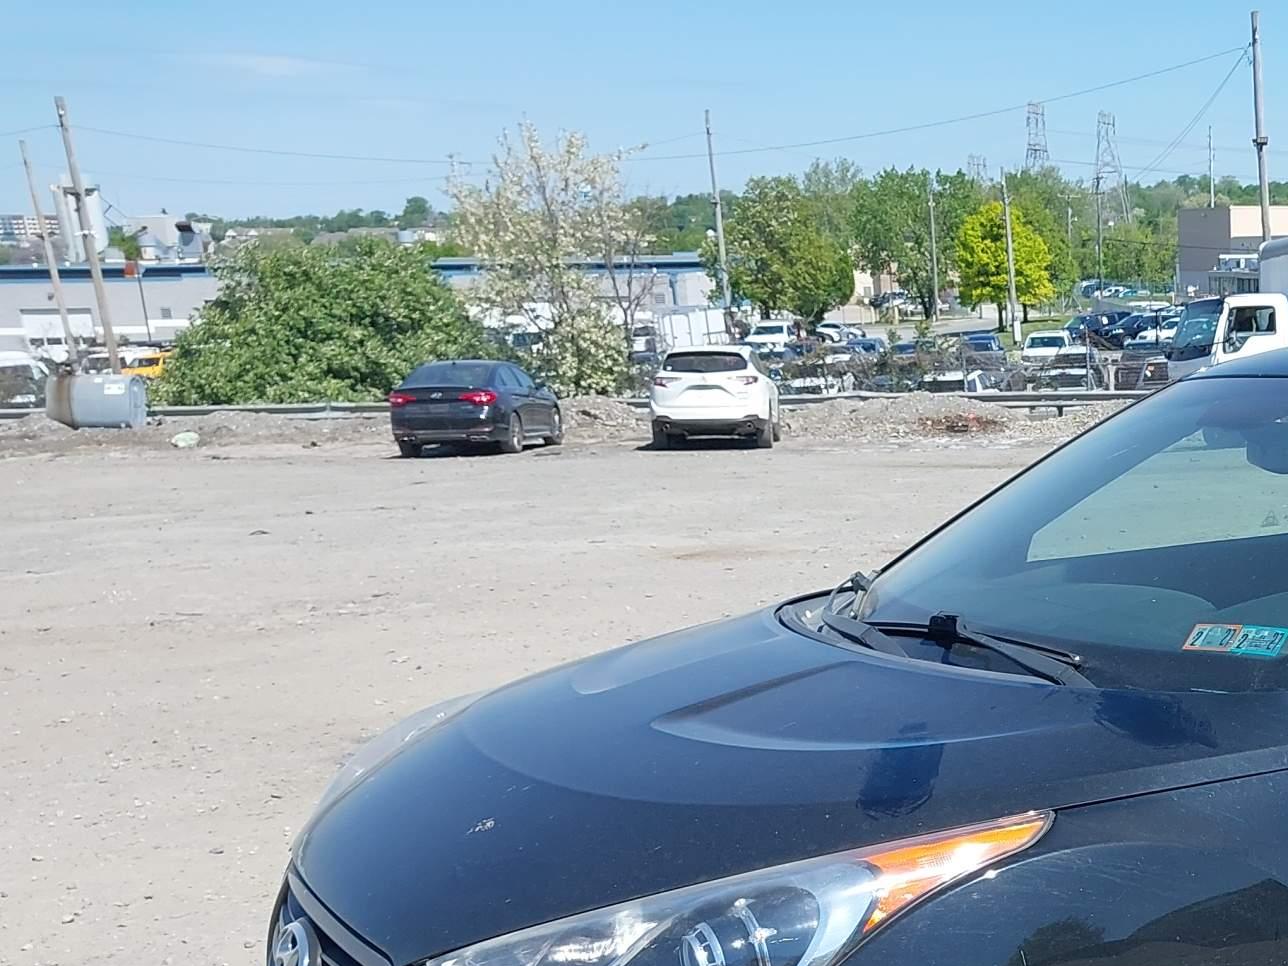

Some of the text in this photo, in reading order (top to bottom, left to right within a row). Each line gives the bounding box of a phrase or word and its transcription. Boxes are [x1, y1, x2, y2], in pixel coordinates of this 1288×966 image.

[1190, 631, 1204, 646] 2
[1219, 628, 1237, 647] 27
[1236, 633, 1249, 649] 2
[1266, 632, 1285, 651] 27
